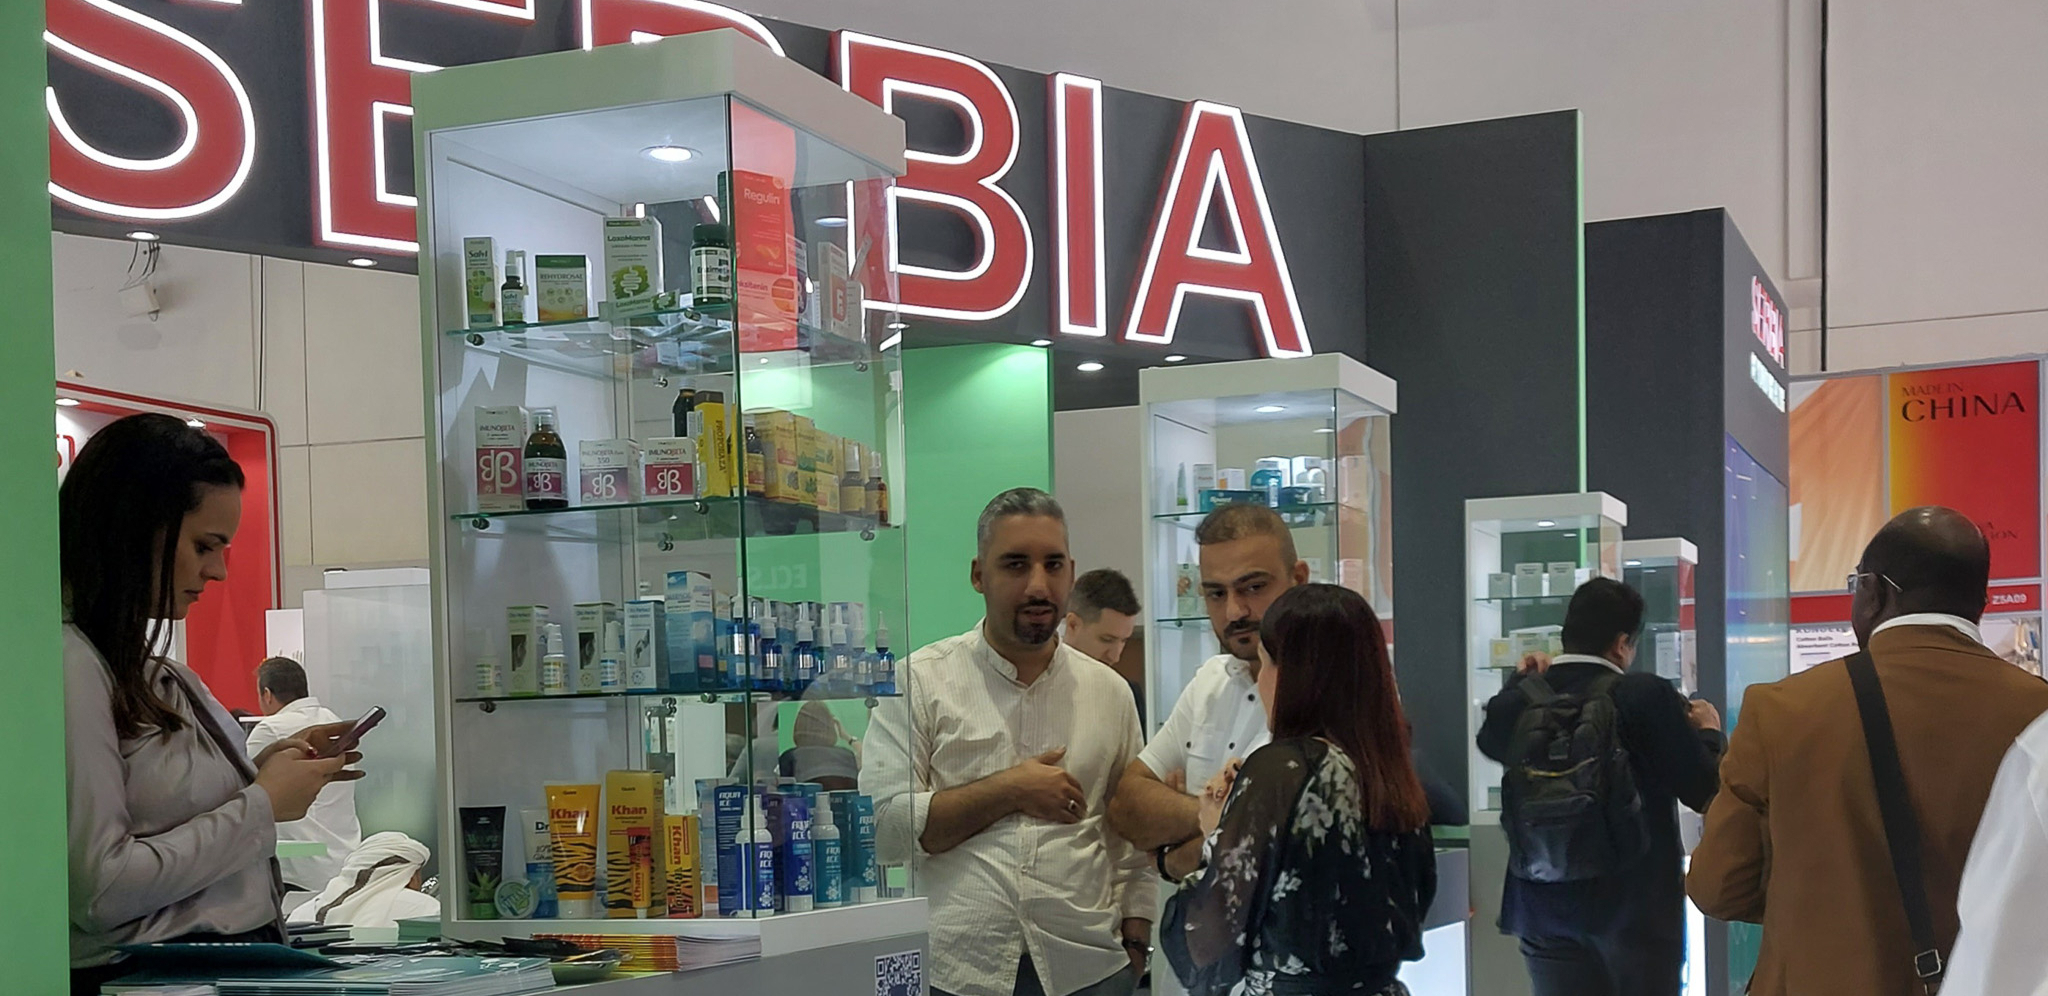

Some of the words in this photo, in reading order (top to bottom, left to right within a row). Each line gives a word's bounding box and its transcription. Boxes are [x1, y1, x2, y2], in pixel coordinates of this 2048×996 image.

[46, 0, 1312, 359] SEBIA
[743, 187, 781, 205] Regulin
[1901, 382, 1944, 398] MADE
[1947, 381, 1964, 393] IN
[1901, 391, 2026, 423] CHINA
[719, 791, 741, 799] AQUA
[612, 805, 648, 815] Khan
[719, 799, 731, 807] ICE
[551, 808, 590, 819] Khan
[792, 831, 805, 840] ICE
[672, 825, 682, 865] Khan
[759, 860, 772, 868] ICE
[633, 872, 642, 902] Khan
